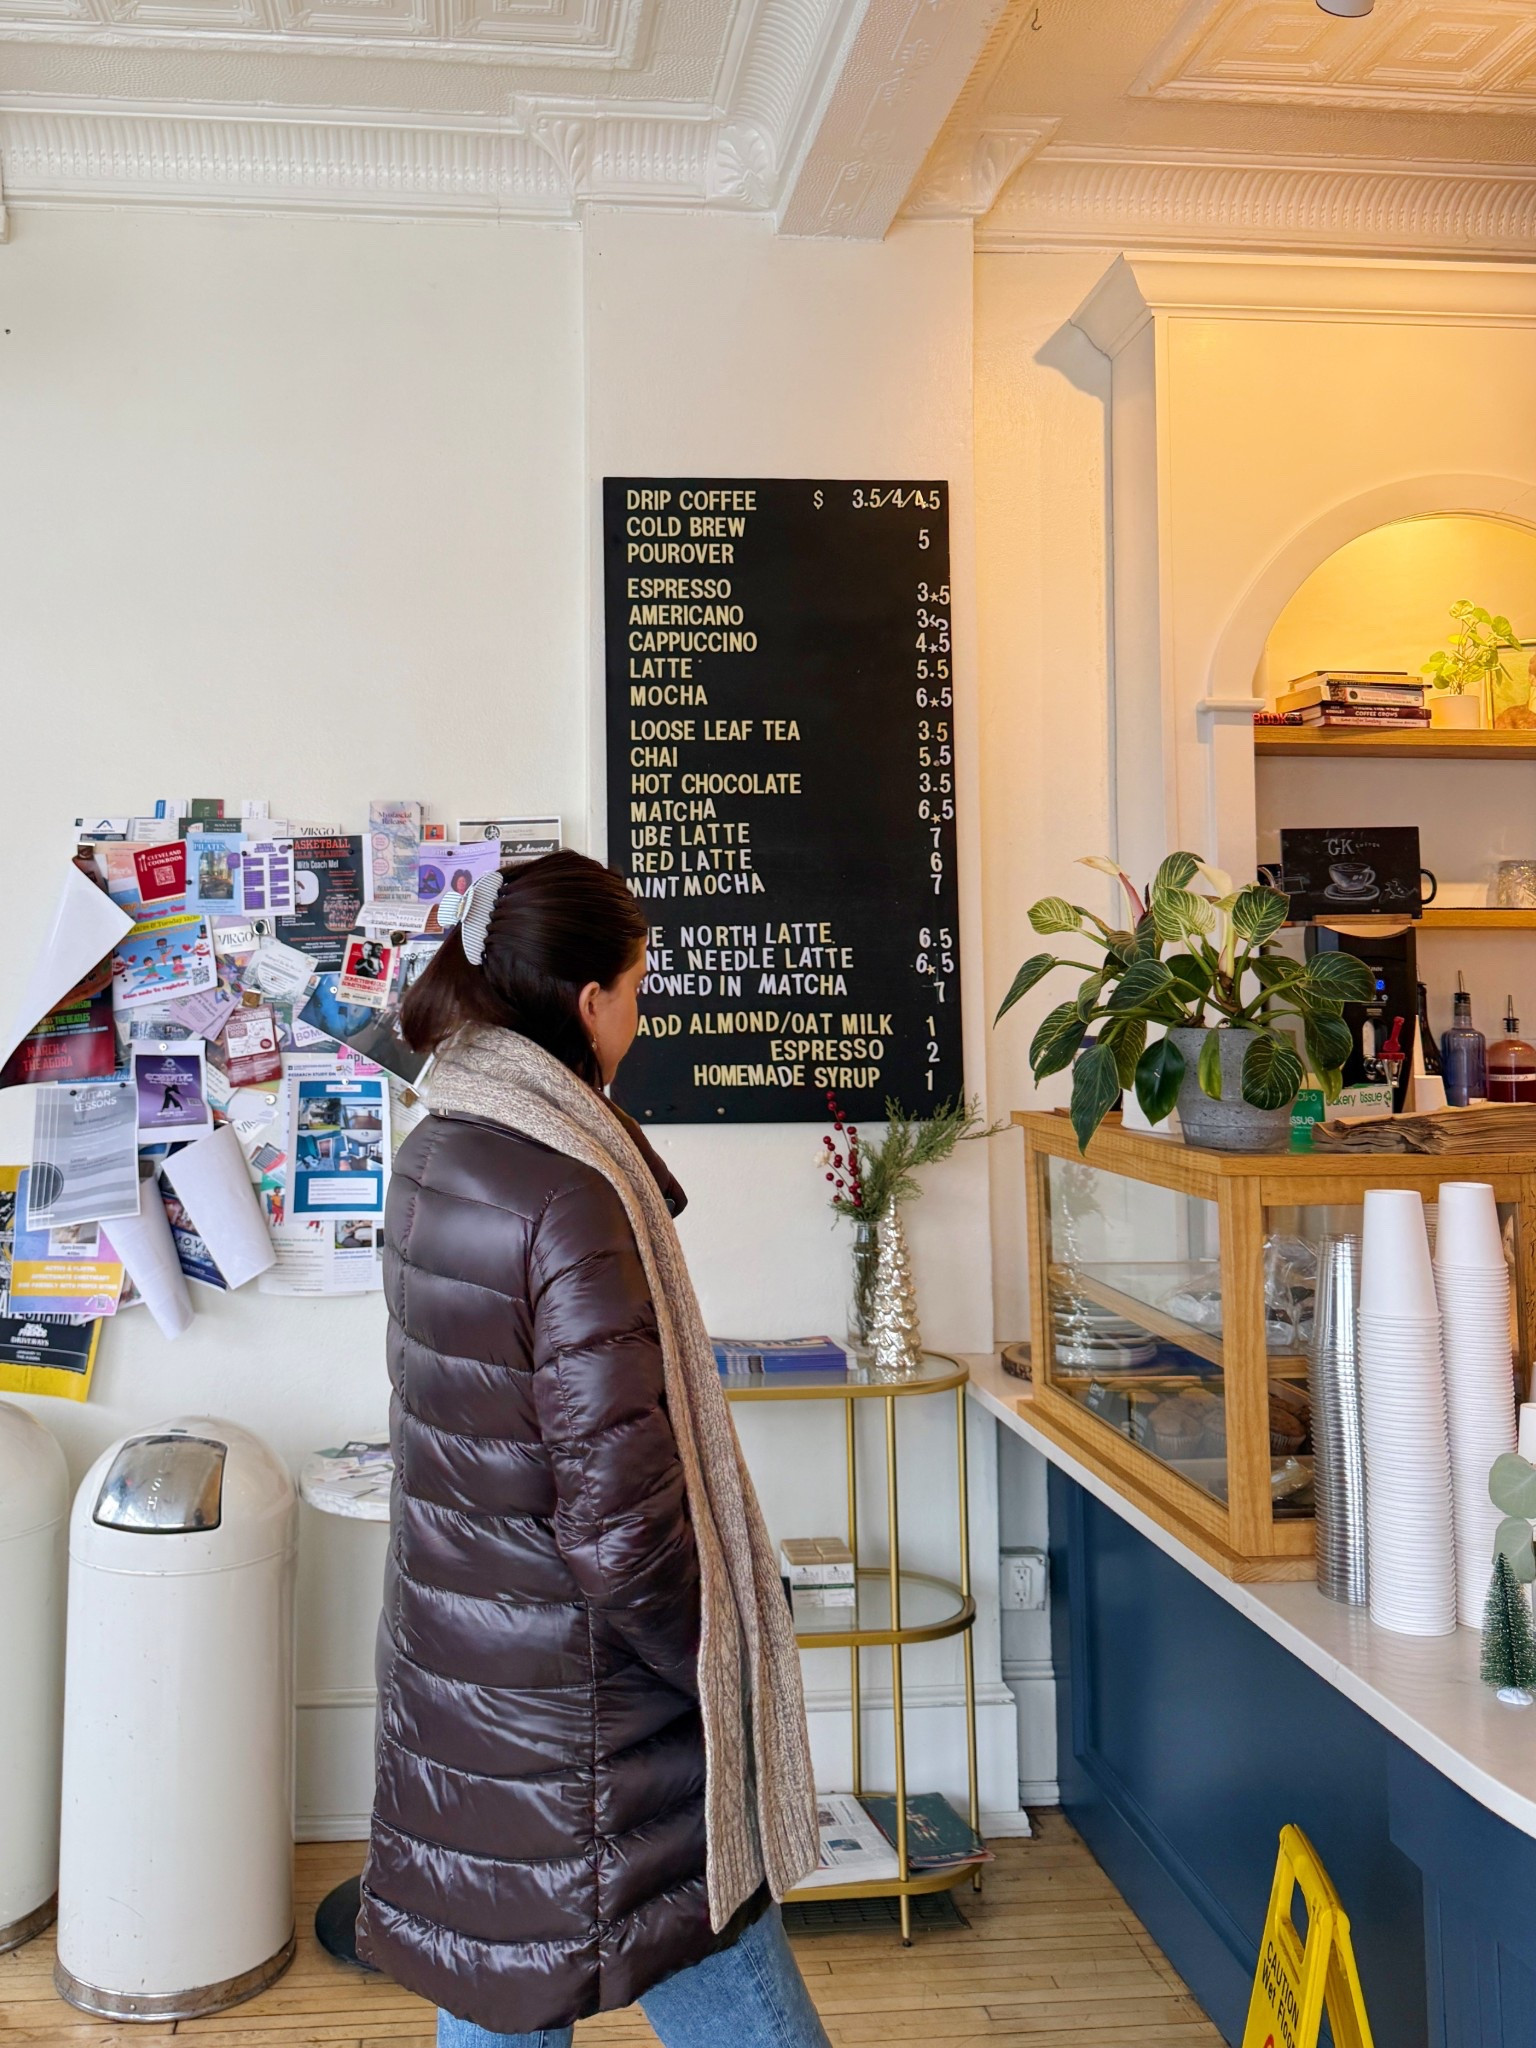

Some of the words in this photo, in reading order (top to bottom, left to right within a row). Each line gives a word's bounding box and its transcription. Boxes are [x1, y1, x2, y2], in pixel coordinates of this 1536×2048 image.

[628, 490, 671, 510] DRIP
[680, 490, 756, 510] COFFEE
[813, 489, 824, 510] $
[627, 517, 681, 536] COLD
[690, 517, 745, 537] BREW
[919, 529, 929, 549] 5
[628, 543, 733, 563] POUROVER
[628, 578, 731, 598] ESPRESSO
[629, 605, 743, 625] AMERICANO
[629, 632, 757, 652] CAPPUCCINO
[631, 658, 692, 678] LATTE
[917, 659, 948, 679] 5.5
[631, 685, 707, 706] MOCHA
[631, 720, 695, 740] LOOSE
[705, 721, 753, 740] LEAF
[763, 721, 800, 740] TEA
[919, 721, 947, 741] 3.5
[631, 747, 677, 767] CHAI
[920, 745, 951, 767] 5.5
[632, 774, 672, 794] HOT
[682, 774, 801, 793] CHOCOLATE
[920, 773, 951, 793] 3.5
[631, 798, 716, 822] MATCHA
[632, 826, 672, 849] UBE
[681, 823, 749, 846] LATTE
[930, 828, 941, 848] 7
[147, 849, 182, 860] CLEVELAND
[1327, 839, 1355, 856] GK
[147, 855, 183, 866] COOKBOOK
[632, 851, 673, 873] RED
[682, 849, 752, 871] LATTE
[931, 852, 942, 872] 6
[626, 876, 679, 899] MINT
[684, 873, 765, 897] MOCHA
[931, 874, 942, 894] 7
[218, 932, 254, 945] VIRGO
[681, 926, 756, 947] NORTH
[766, 923, 832, 944] LATTE
[920, 928, 952, 949] 6.5
[688, 948, 774, 971] NEEDLE
[785, 947, 853, 968] LATTE
[720, 975, 741, 996] IN
[758, 973, 847, 995] MATCHA
[934, 982, 945, 1003] 7
[637, 1015, 681, 1038] ADD
[690, 1011, 833, 1034] ALMOND/OAT
[842, 1014, 893, 1034] MILK
[926, 1016, 935, 1037] 1
[27, 1045, 59, 1058] MARCH
[771, 1039, 883, 1061] ESPRESSO
[927, 1042, 940, 1063] 2
[23, 1059, 41, 1072] THE
[42, 1055, 73, 1069] AGORA
[694, 1064, 804, 1087] HOMEMADE
[815, 1067, 880, 1088] SYRUP
[925, 1070, 933, 1091] 1
[74, 1096, 117, 1112] LESSONS
[1360, 1090, 1382, 1104] tissue
[1262, 1957, 1277, 2009] Wet
[1267, 1940, 1300, 2031] CAUTION
